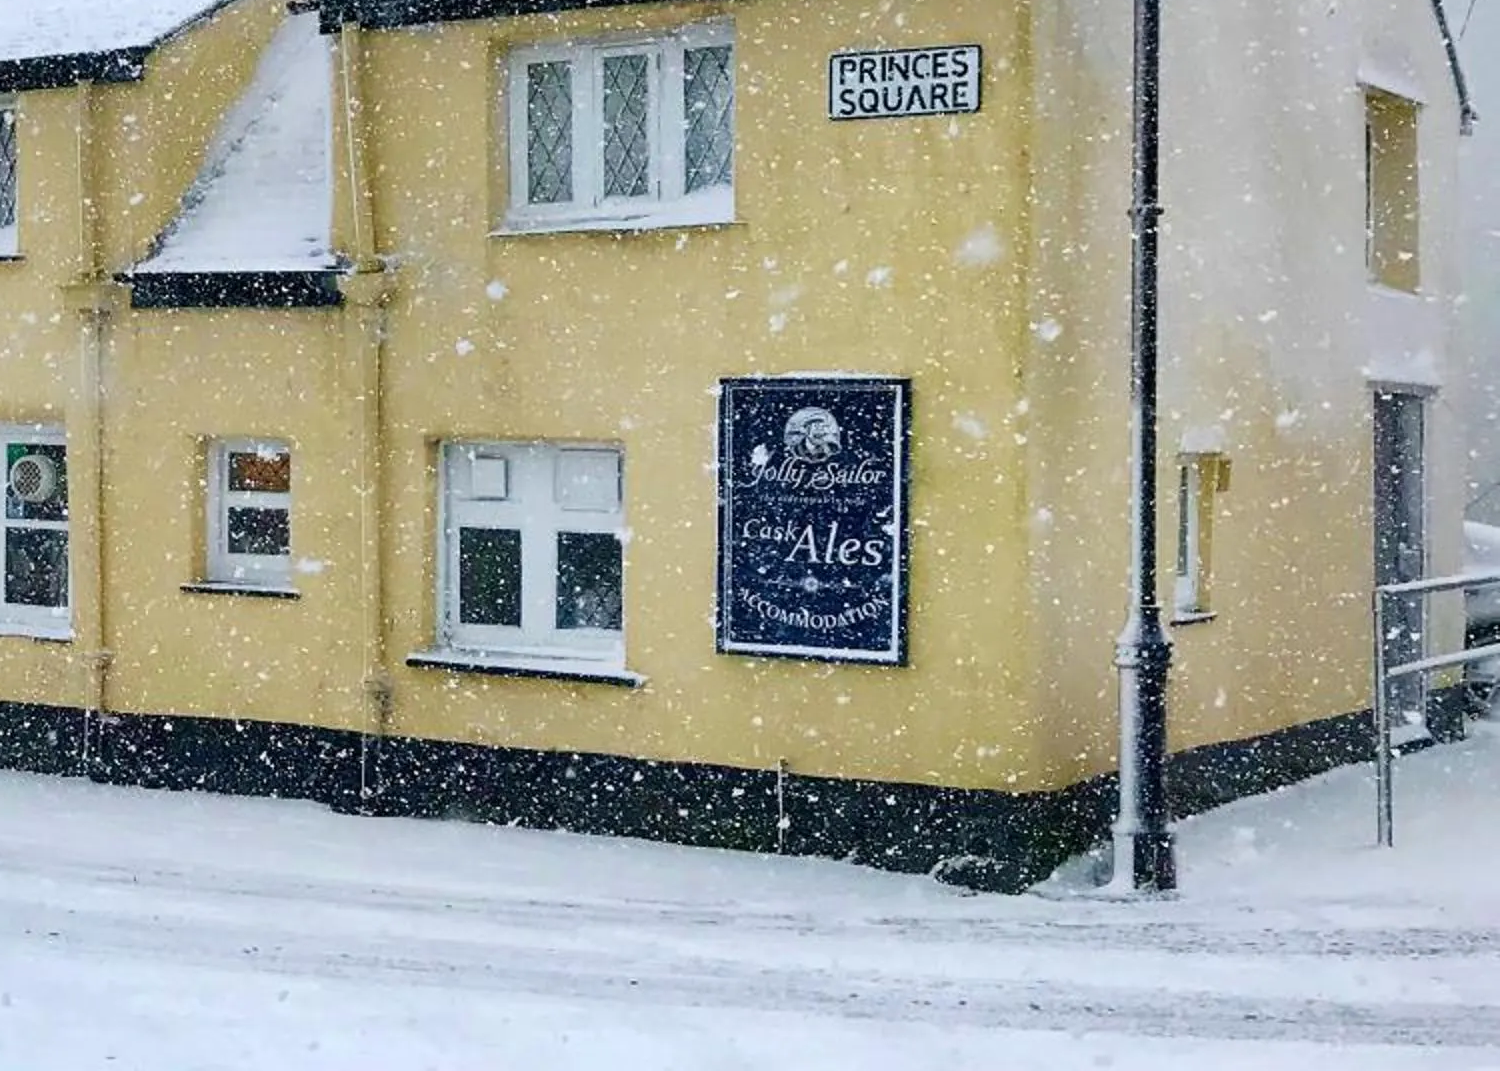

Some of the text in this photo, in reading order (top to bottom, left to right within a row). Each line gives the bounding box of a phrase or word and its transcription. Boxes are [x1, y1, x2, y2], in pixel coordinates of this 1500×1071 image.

[839, 50, 969, 86] PRINCES
[839, 81, 969, 116] SQUARE
[737, 452, 887, 490] Jolly Sailor
[743, 519, 885, 566] Cask Ales
[738, 588, 889, 628] ACCOMMODATION
